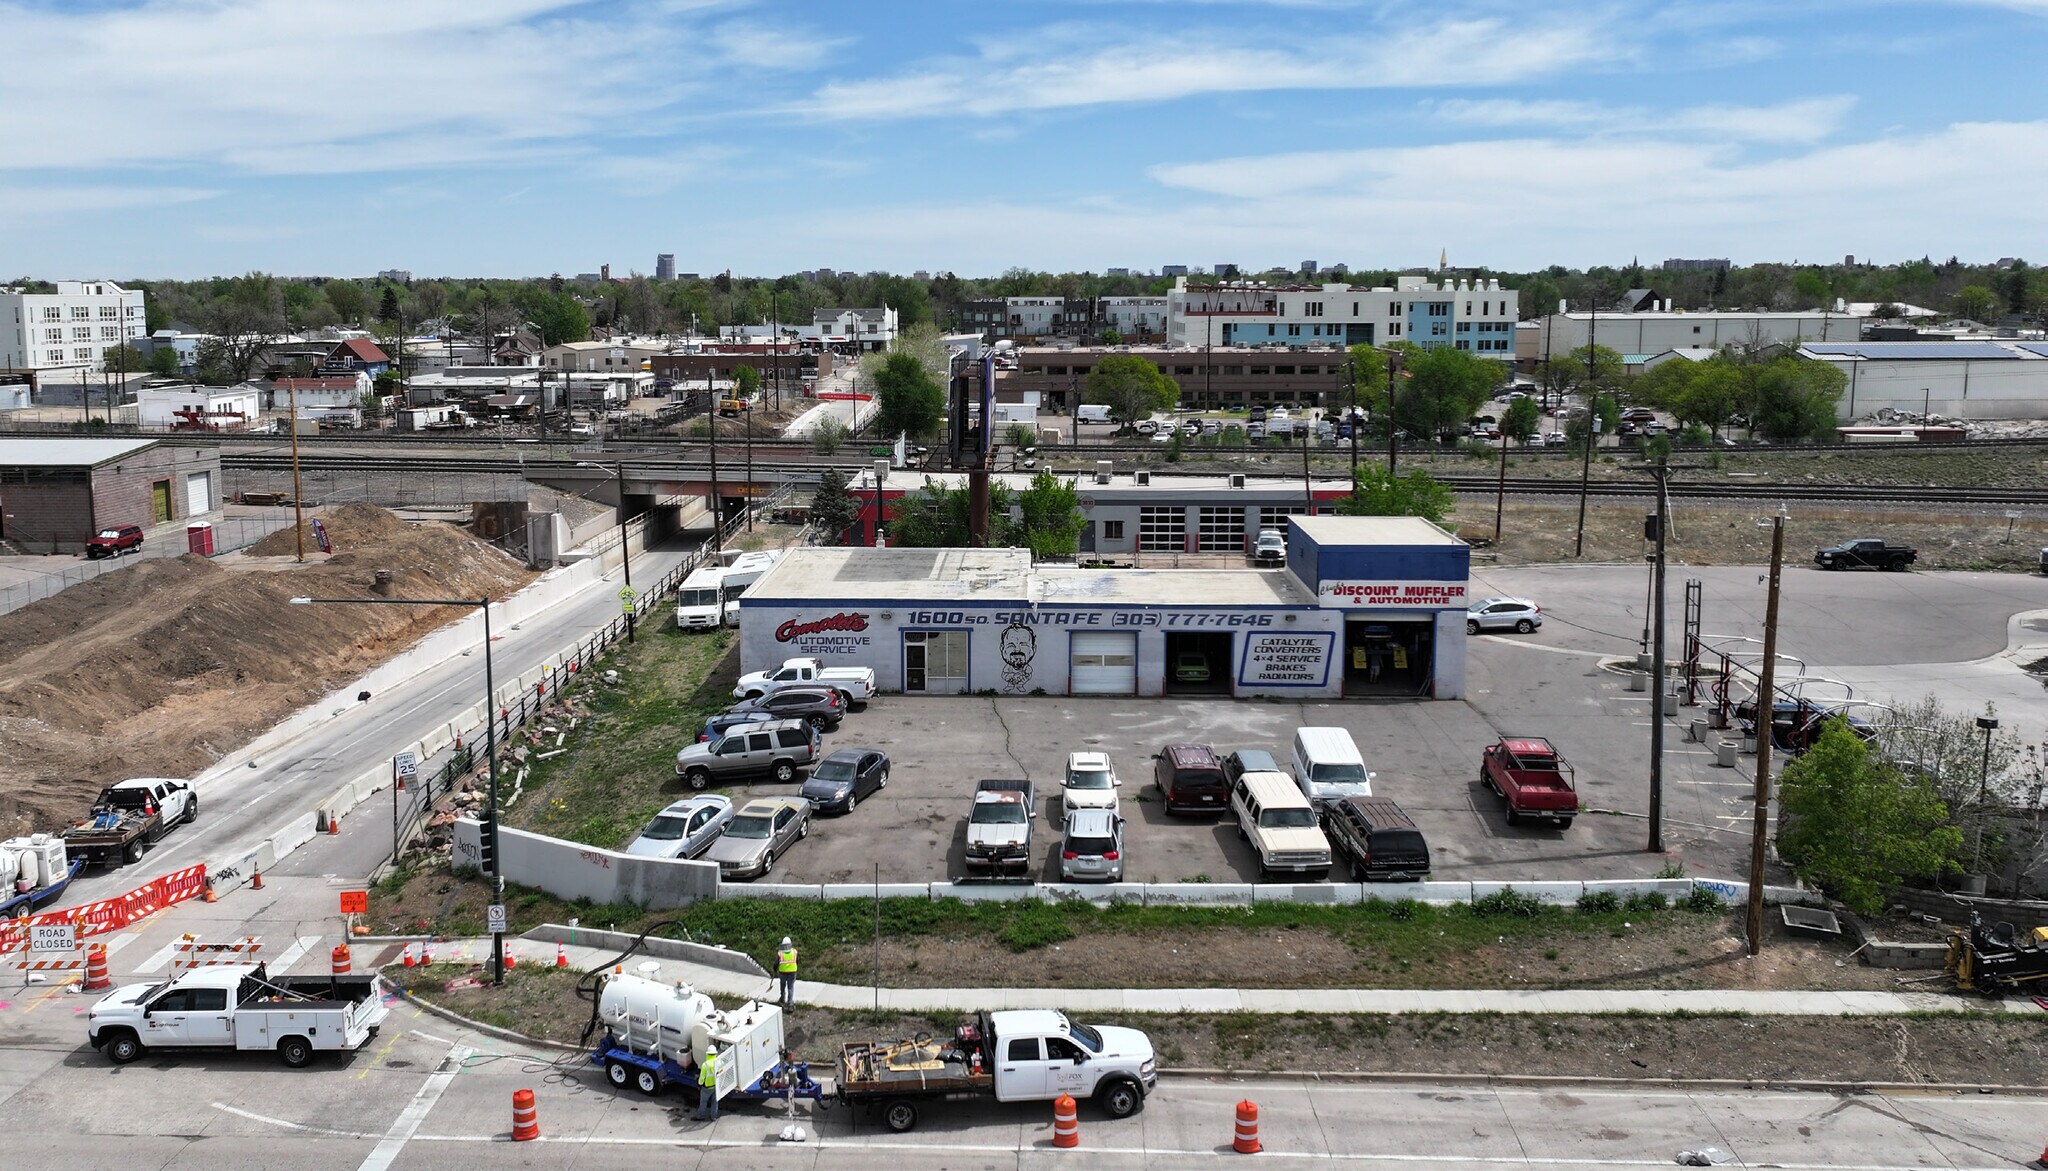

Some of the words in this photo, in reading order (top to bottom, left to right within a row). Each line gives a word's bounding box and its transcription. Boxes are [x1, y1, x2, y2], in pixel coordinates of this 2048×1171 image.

[1333, 585, 1399, 596] DISCOUNT
[1405, 586, 1465, 597] MUFFLER
[1353, 596, 1362, 604] &
[1368, 596, 1450, 604] AUTOMOTIVE
[908, 611, 964, 624] 1600
[1111, 611, 1162, 628] (303)
[1167, 613, 1274, 626] 777-7646
[775, 612, 870, 642] Complete
[790, 636, 870, 645] AUTOMOTIVE
[1261, 638, 1317, 646] CATALYTIC
[800, 645, 856, 653] SERVICE
[1254, 646, 1322, 654] CONVERTERS
[1275, 655, 1322, 663] SERVICE
[400, 763, 416, 774] 25
[39, 929, 66, 938] ROAD
[33, 939, 73, 949] CLOSED
